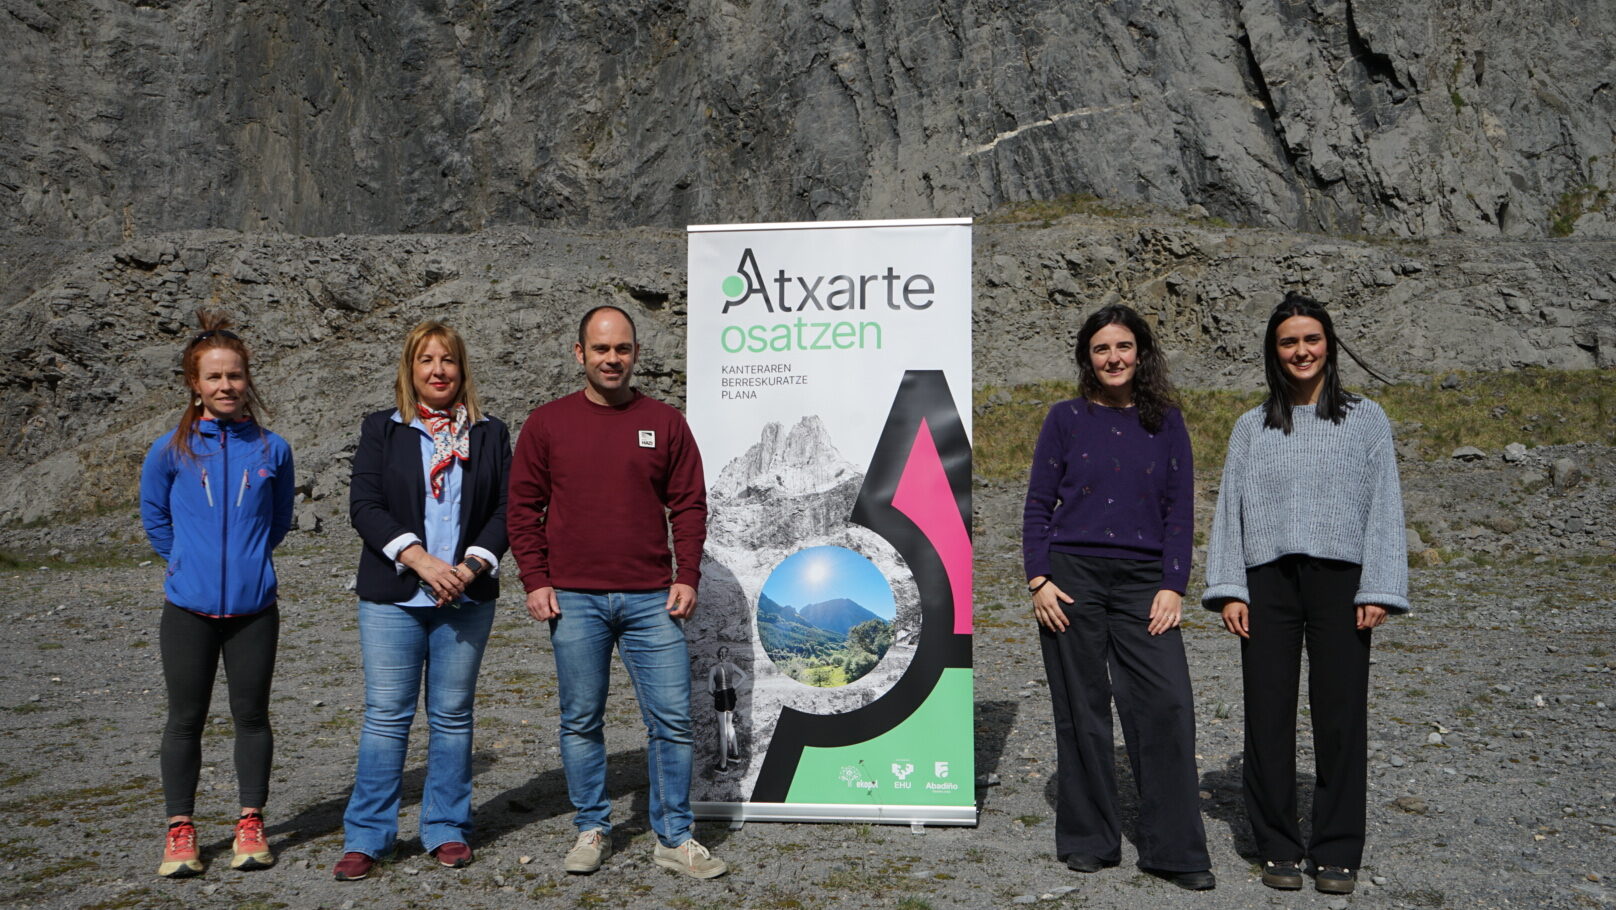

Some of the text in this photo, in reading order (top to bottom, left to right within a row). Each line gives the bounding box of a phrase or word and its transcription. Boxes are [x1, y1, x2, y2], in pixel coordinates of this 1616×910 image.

[722, 248, 935, 313] Atxarte
[721, 317, 882, 353] osatzen
[721, 363, 792, 374] KANTERAREN
[721, 375, 808, 387] BERRESKURATZE
[721, 390, 757, 400] PLANA
